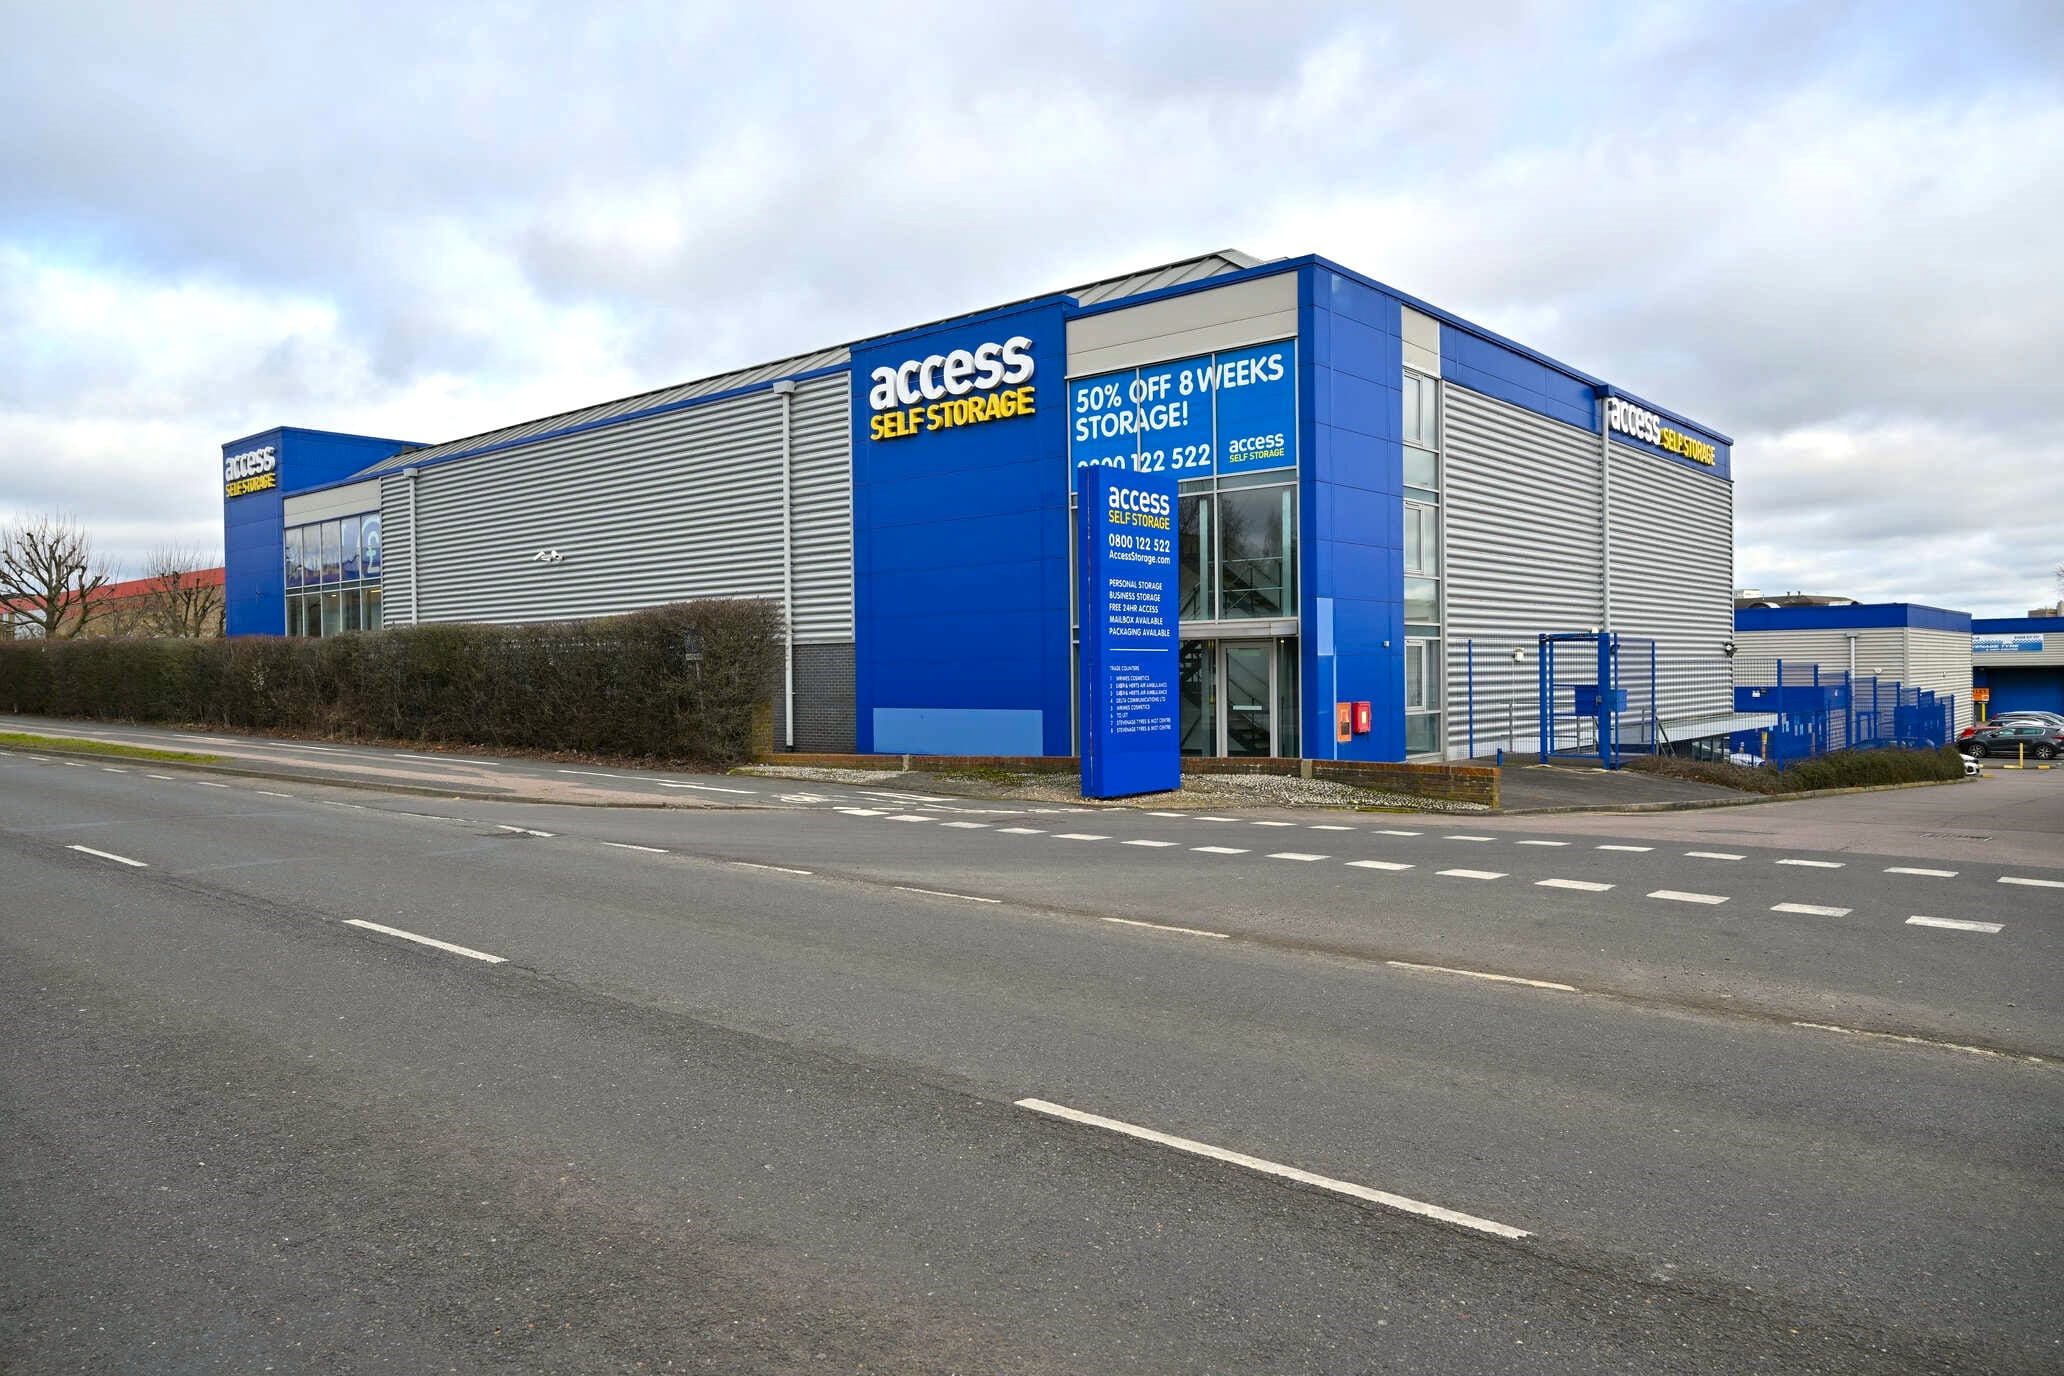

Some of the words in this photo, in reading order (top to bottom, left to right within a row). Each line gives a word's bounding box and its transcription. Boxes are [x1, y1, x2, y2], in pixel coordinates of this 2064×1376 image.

[870, 336, 1034, 410] access
[1076, 383, 1122, 413] 50%
[1129, 374, 1172, 404] OFF
[1179, 370, 1193, 396] 8
[1196, 353, 1284, 393] WEEKS
[871, 408, 925, 440] SELF
[927, 386, 1035, 430] STORAGE
[1076, 401, 1188, 441] STORAGE!
[1608, 397, 1660, 445] access
[1229, 433, 1285, 453] access
[1661, 427, 1683, 453] SELF
[1684, 436, 1716, 466] STORAGE
[225, 446, 275, 481] access
[1130, 450, 1165, 473] 122
[1171, 443, 1211, 469] 522
[1229, 453, 1248, 463] SELF
[1249, 448, 1285, 460] STORAGE
[226, 480, 243, 497] SELF
[243, 472, 276, 493] STORAGE
[1109, 486, 1170, 515] access
[1109, 509, 1131, 525] SELF
[1132, 513, 1170, 530] STORAGE
[1109, 533, 1133, 549] 0800
[1136, 536, 1151, 551] 122
[1154, 539, 1170, 553] 522
[1109, 549, 1171, 565] AccessStorage.com
[1109, 579, 1137, 589] PERSONAL
[1139, 581, 1163, 590] STORAGE
[1109, 591, 1135, 600] BUSINESS
[1136, 592, 1161, 602] STORAGE
[1109, 603, 1121, 612] FREE
[1122, 604, 1138, 612] 24HR
[1138, 605, 1159, 613] ACCESS
[1109, 627, 1141, 636] PACKAGING
[1142, 629, 1170, 637] AVAILABLE
[1110, 616, 1134, 624] MAILBOX
[1135, 616, 1163, 625] AVAILABLE
